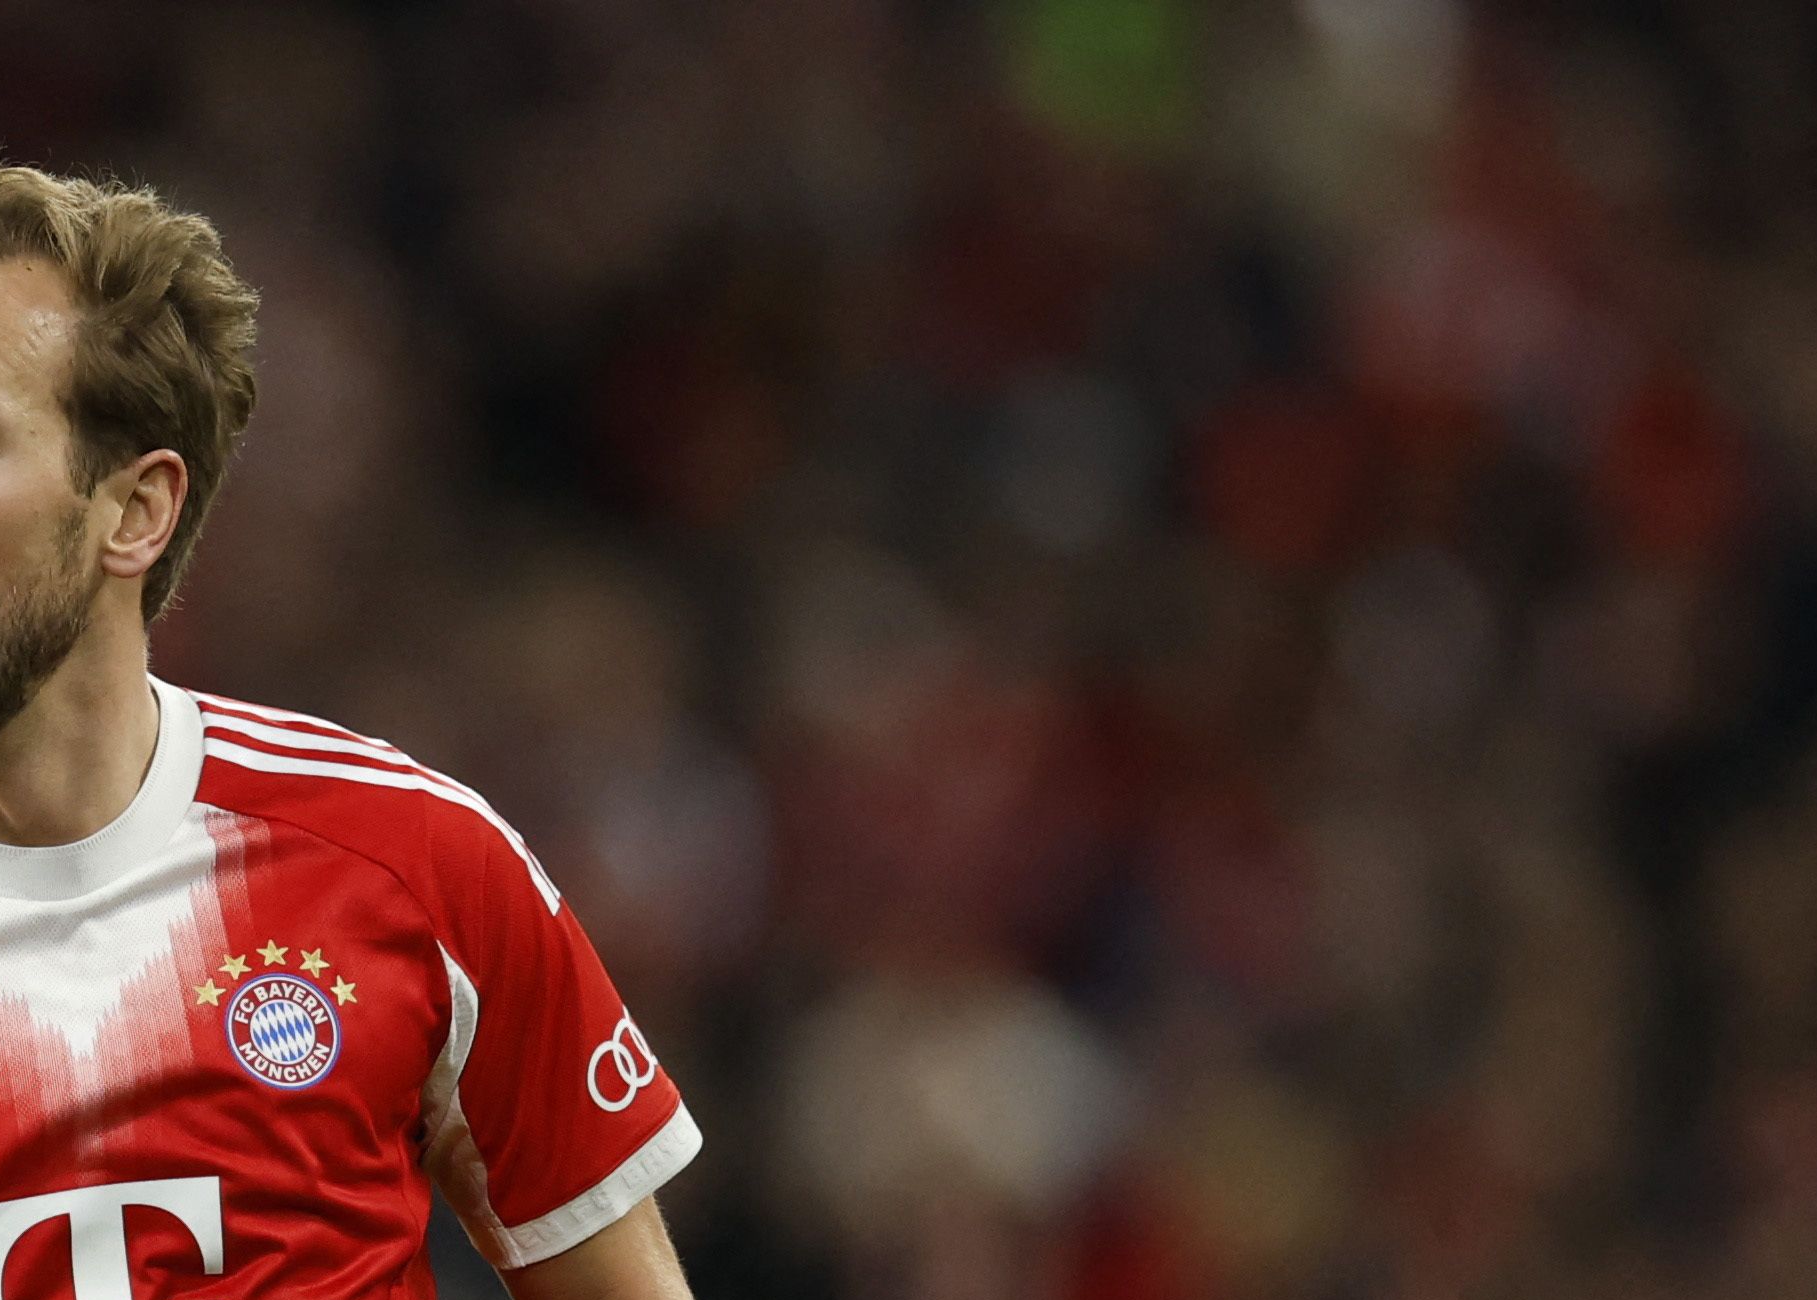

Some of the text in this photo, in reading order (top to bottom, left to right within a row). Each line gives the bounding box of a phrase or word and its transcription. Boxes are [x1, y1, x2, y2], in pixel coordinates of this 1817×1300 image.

[234, 982, 329, 1025] FC BAYERN
[239, 1042, 330, 1082] MÜNCHEN
